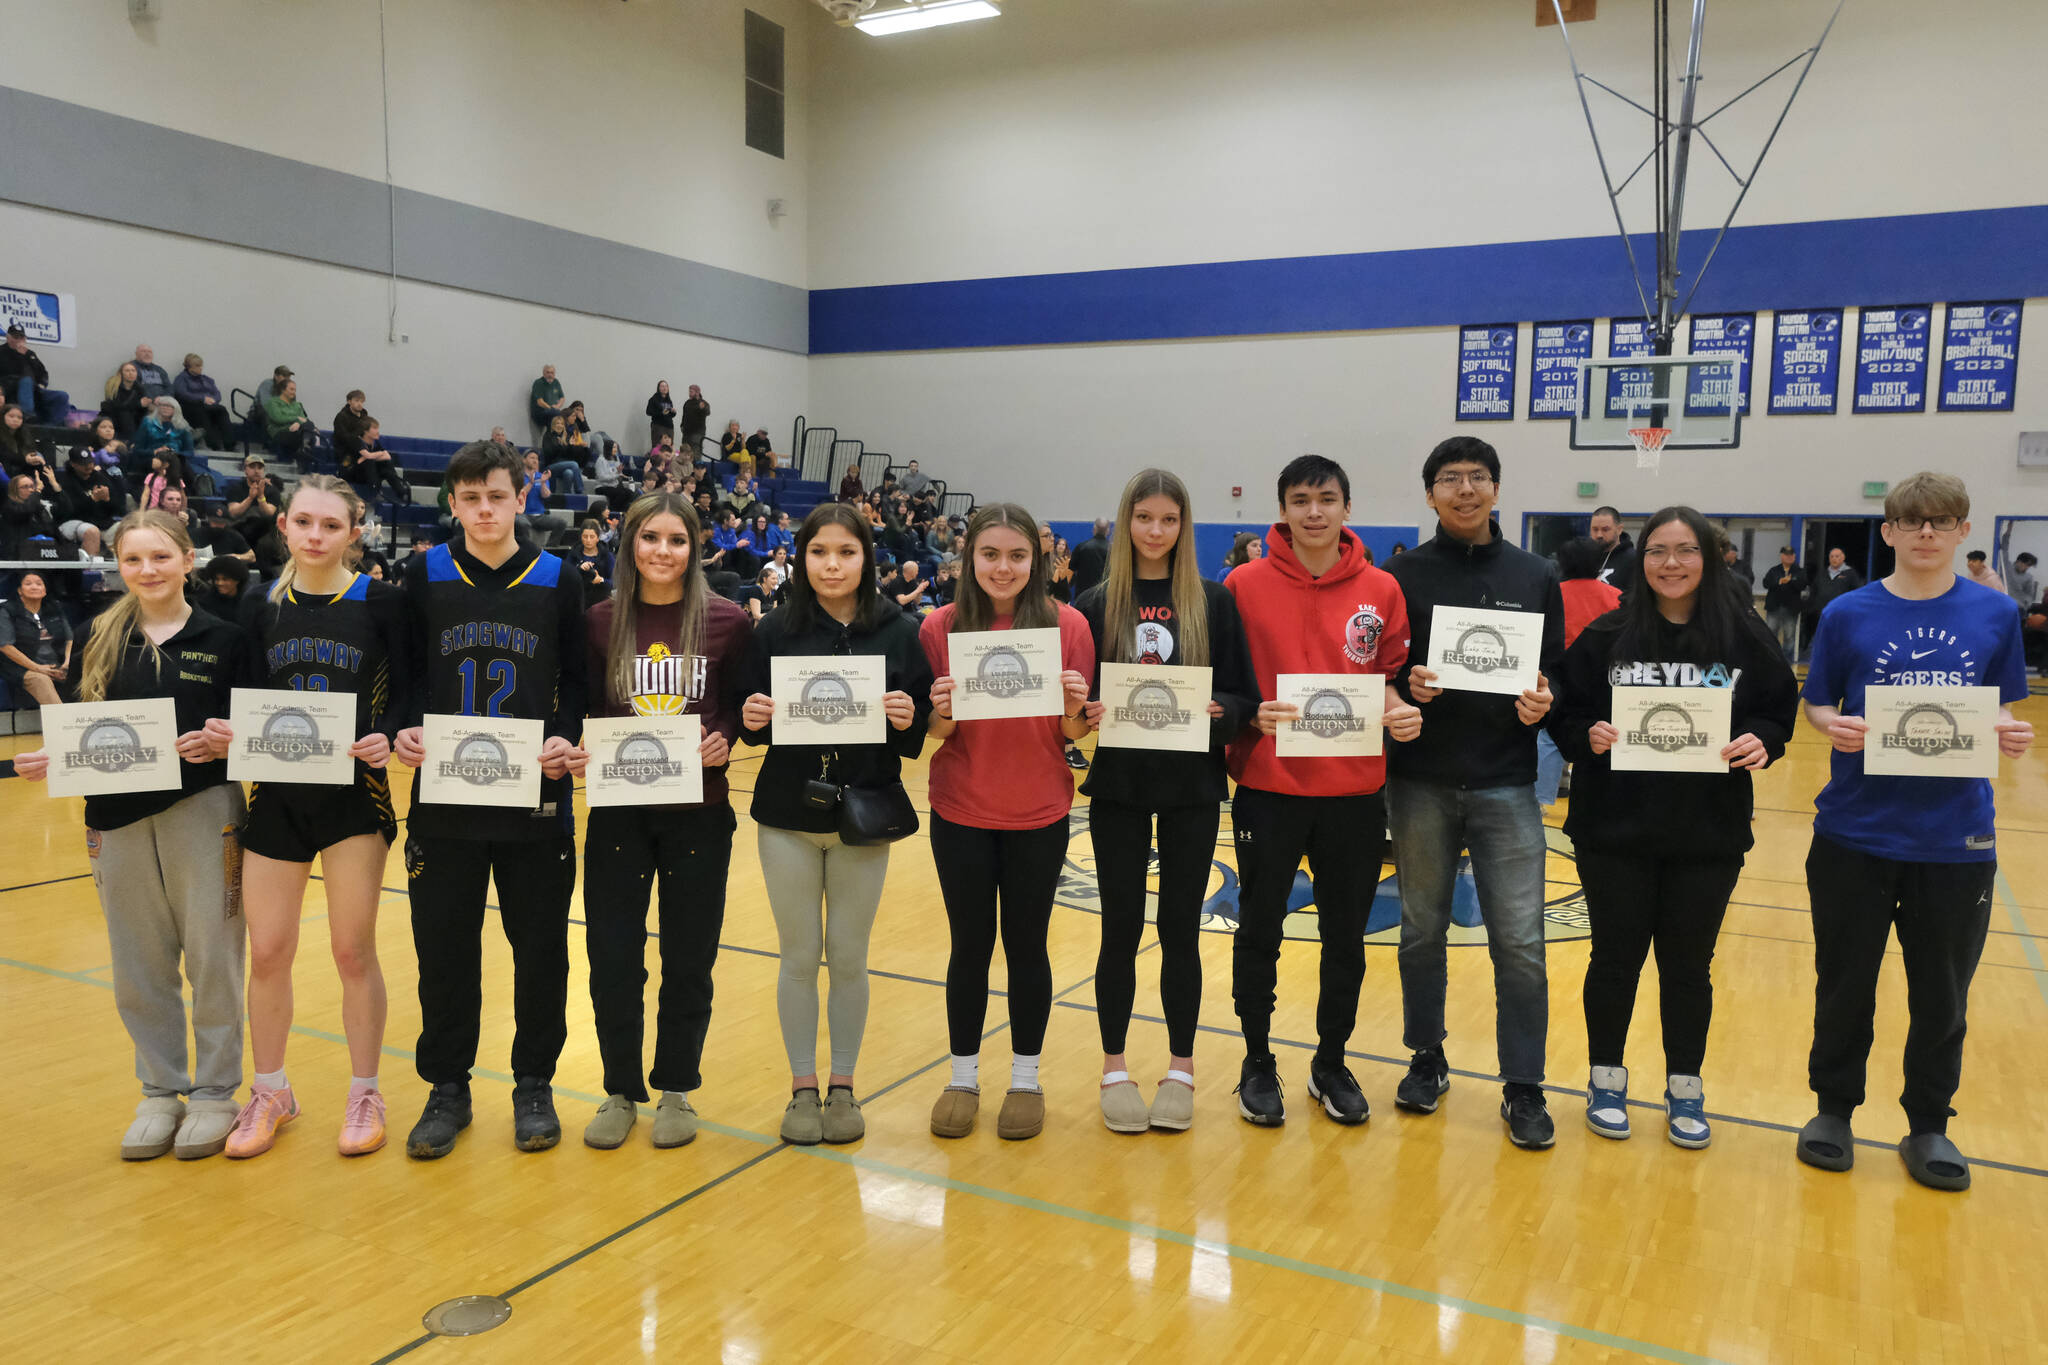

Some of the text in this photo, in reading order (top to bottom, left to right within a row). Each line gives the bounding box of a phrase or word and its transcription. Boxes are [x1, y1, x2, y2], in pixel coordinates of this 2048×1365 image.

[3, 304, 37, 318] Paint
[1970, 337, 1992, 345] BOYS
[1783, 349, 1828, 365] SOCCER
[1861, 347, 1924, 364] SWIM/DIVE
[1945, 344, 2014, 361] BASKETBALL
[1462, 359, 1511, 373] SOFTBALL
[1536, 356, 1583, 372] SOFTBAL
[1784, 363, 1826, 374] 2021
[1868, 362, 1916, 373] 2023
[1954, 360, 2005, 370] 2023
[1468, 374, 1504, 383] 2016
[1542, 372, 1578, 381] 2017
[1544, 385, 1575, 399] STATE
[1621, 383, 1653, 397] STATE
[1786, 383, 1821, 395] STATE
[1871, 382, 1909, 395] STATE
[1957, 379, 1996, 393] STATE
[1470, 387, 1500, 400] STATE
[1690, 392, 1746, 407] CHAMPIOS
[1858, 393, 1920, 407] RUNNER UP
[1946, 392, 2006, 405] RUNNER UP
[1460, 400, 1509, 414] CHAMPIONS
[1773, 394, 1832, 408] CHAMPIONS
[1358, 604, 1377, 613] KAKE
[440, 621, 540, 658] SKAGWAY
[1905, 627, 1957, 646] 76ERS
[267, 637, 363, 674] SKAGWAY
[1446, 651, 1517, 669] REGION V
[969, 676, 1040, 691] REGION V
[1889, 671, 1963, 687] 76ERS
[455, 657, 517, 718] 12
[792, 703, 865, 716] REGION V
[1118, 708, 1188, 723] REGION V
[1305, 712, 1334, 721] Rodney
[1295, 719, 1363, 730] REGION V
[1630, 732, 1706, 745] REGION V
[1885, 735, 1971, 748] REGION V
[252, 739, 331, 754] REGION V
[70, 749, 154, 766] REGION V
[443, 763, 519, 777] REGION V
[606, 763, 680, 777] REGION V
